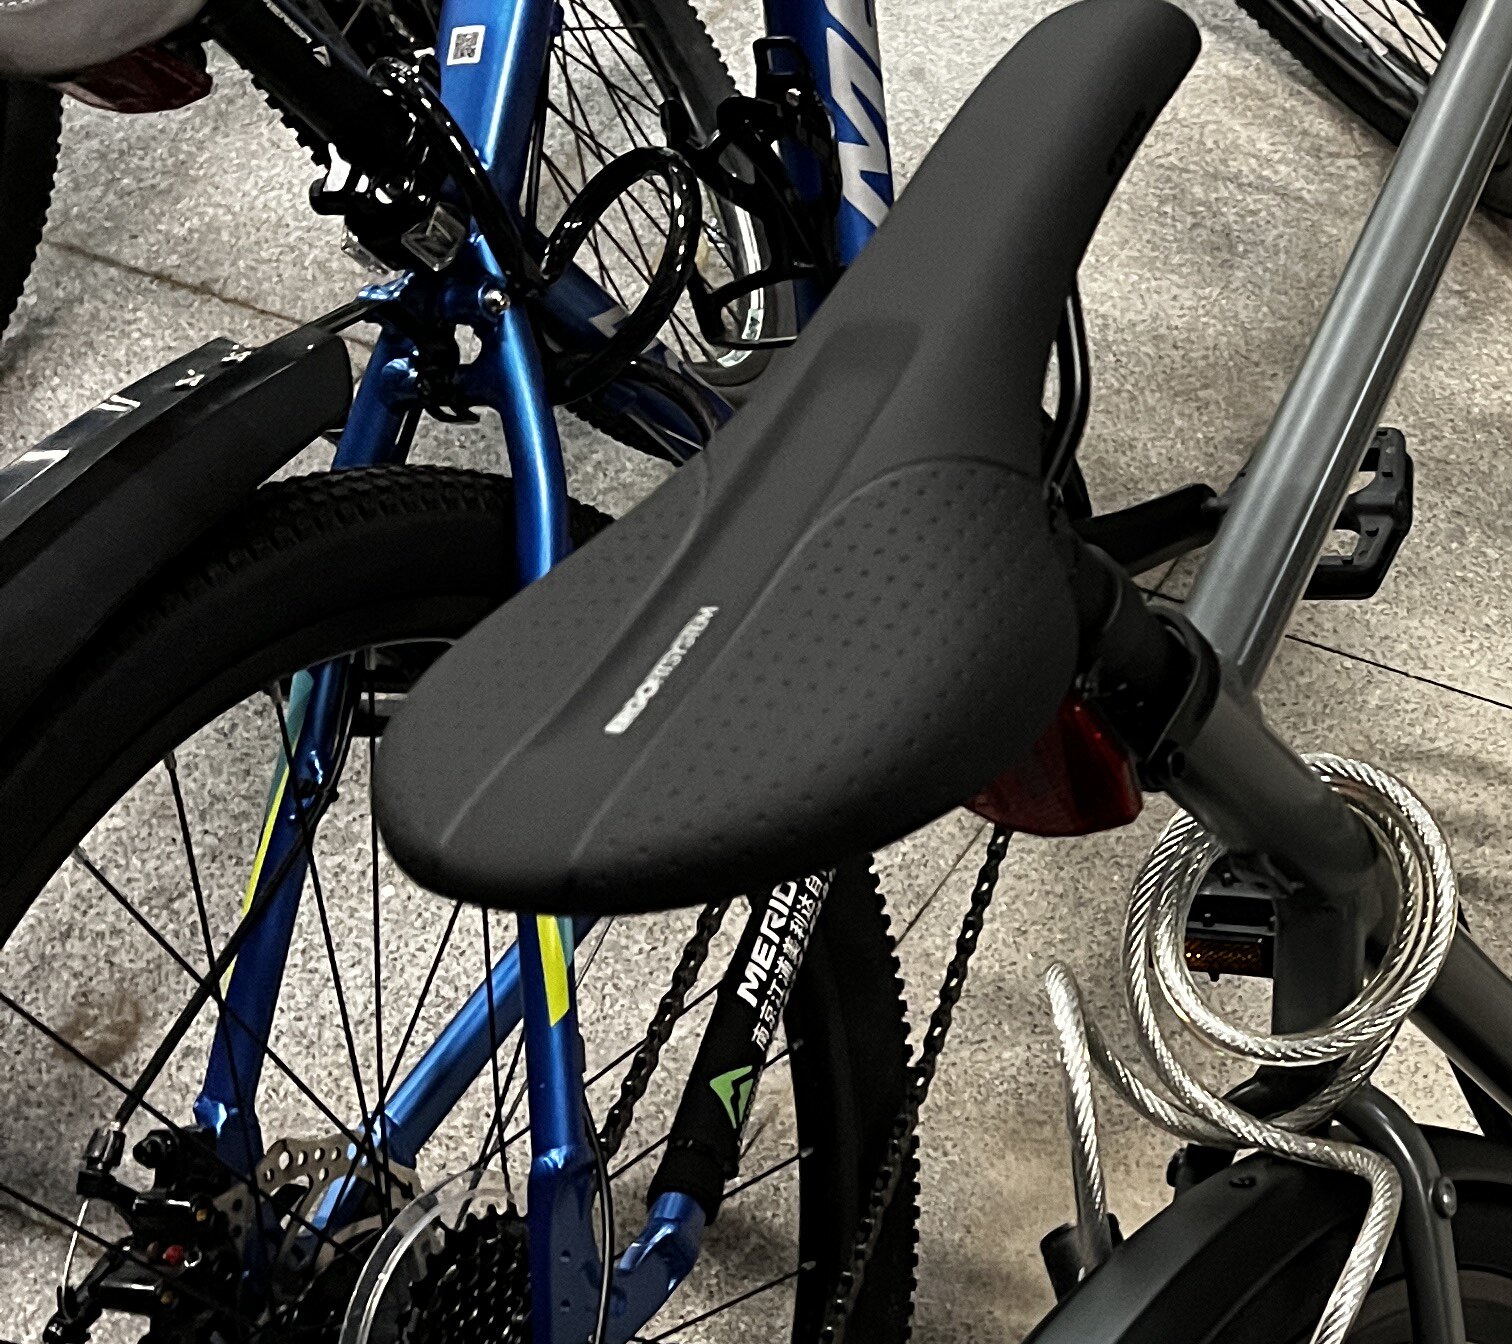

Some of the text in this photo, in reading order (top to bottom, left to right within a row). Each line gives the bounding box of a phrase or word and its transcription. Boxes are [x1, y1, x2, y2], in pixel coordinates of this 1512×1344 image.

[750, 867, 836, 1052] 南京江浦美利达自
